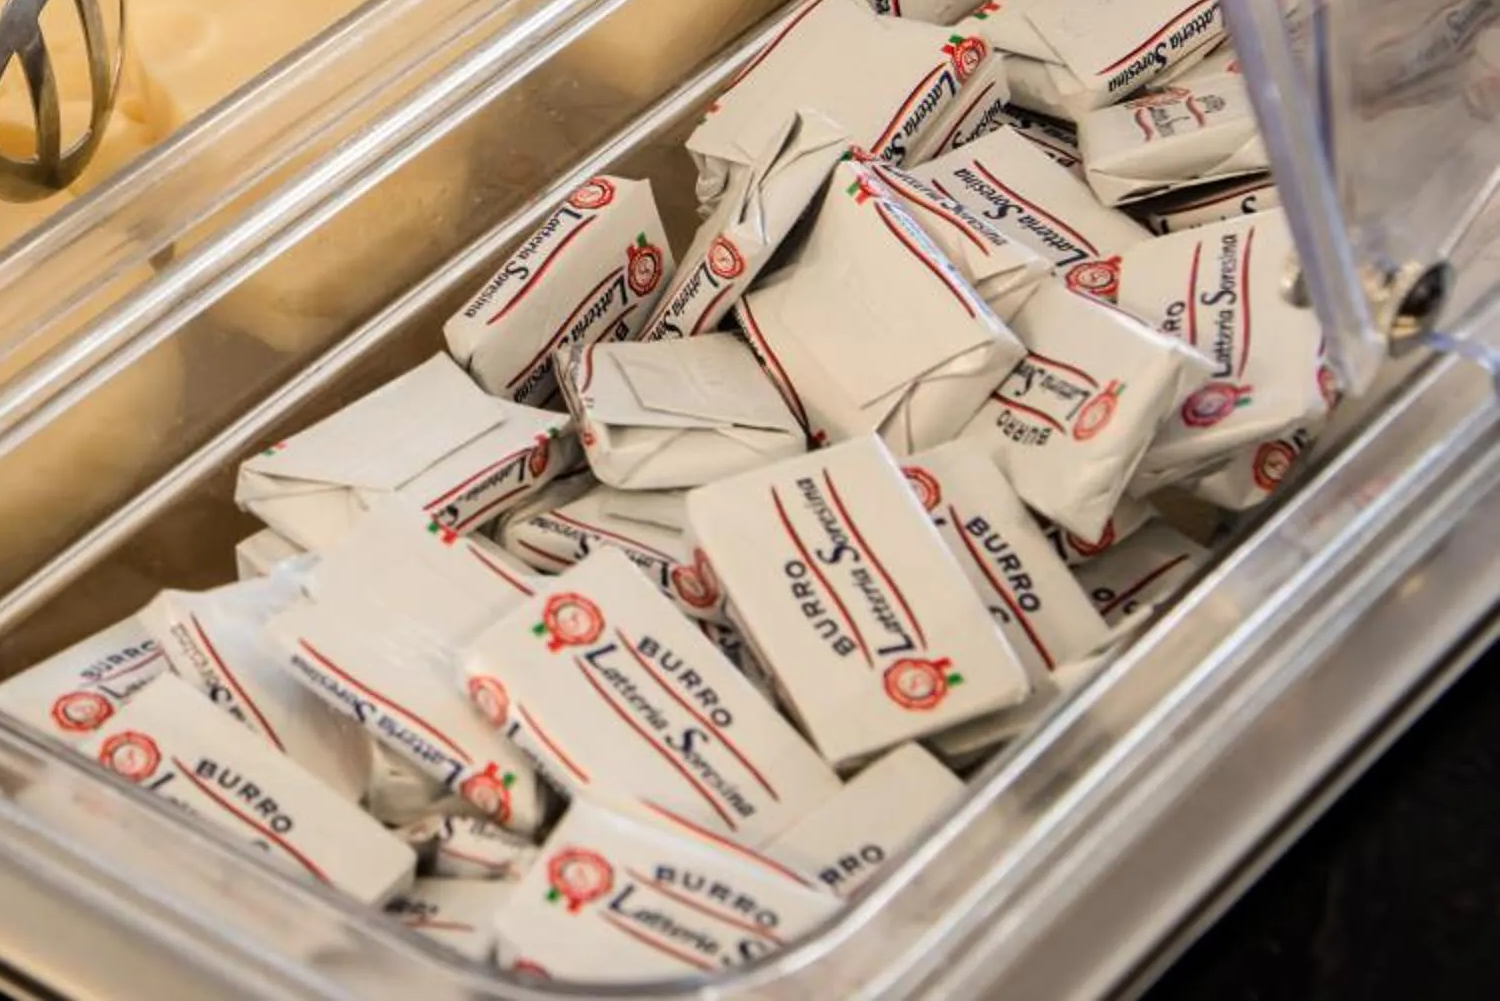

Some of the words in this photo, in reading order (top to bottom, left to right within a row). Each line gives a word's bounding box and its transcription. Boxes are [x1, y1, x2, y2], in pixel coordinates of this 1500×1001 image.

[1106, 40, 1170, 93] Soresina
[903, 70, 957, 136] Latteria
[953, 167, 1024, 219] Soresina
[526, 206, 583, 261] Latteria
[1018, 215, 1090, 267] Latteria
[465, 263, 529, 318] Soresina
[671, 261, 720, 315] Latteria
[1201, 233, 1238, 306] Soresina
[570, 273, 629, 343] Latteria
[795, 476, 861, 565] Soresina
[965, 515, 1041, 614] BURRO
[784, 559, 857, 658] BURRO
[851, 568, 916, 655] Latteria
[638, 635, 733, 728] BURRO
[585, 643, 669, 731] Latteria
[664, 727, 756, 817] Soresina
[195, 759, 294, 834] BURRO
[655, 865, 779, 928] BURRO
[818, 844, 885, 887] RRO
